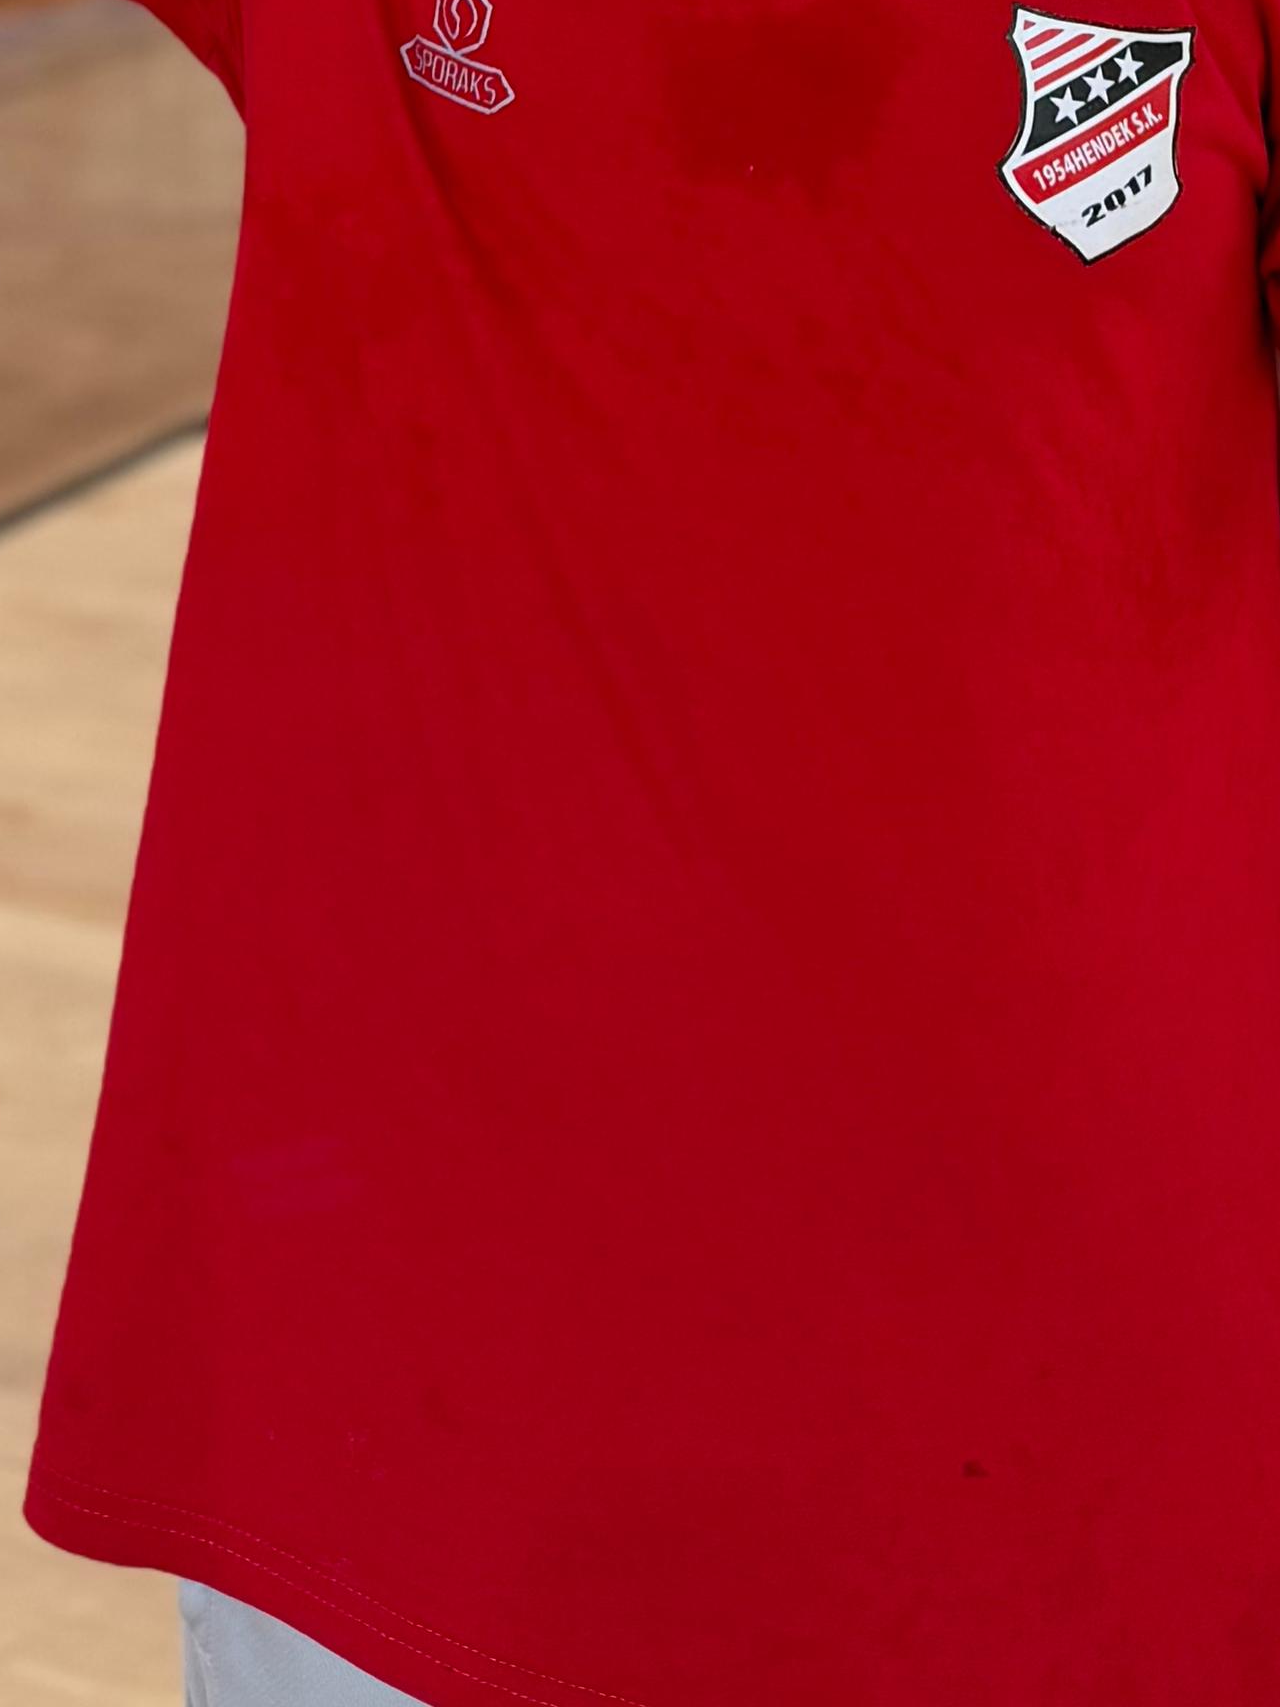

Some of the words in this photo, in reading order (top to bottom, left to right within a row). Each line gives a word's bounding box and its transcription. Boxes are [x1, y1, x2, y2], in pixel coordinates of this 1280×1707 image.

[414, 44, 496, 104] SPORAKS
[1032, 119, 1133, 191] 1954HENDEK
[1133, 103, 1163, 136] S.K.
[1081, 163, 1153, 228] 2017
